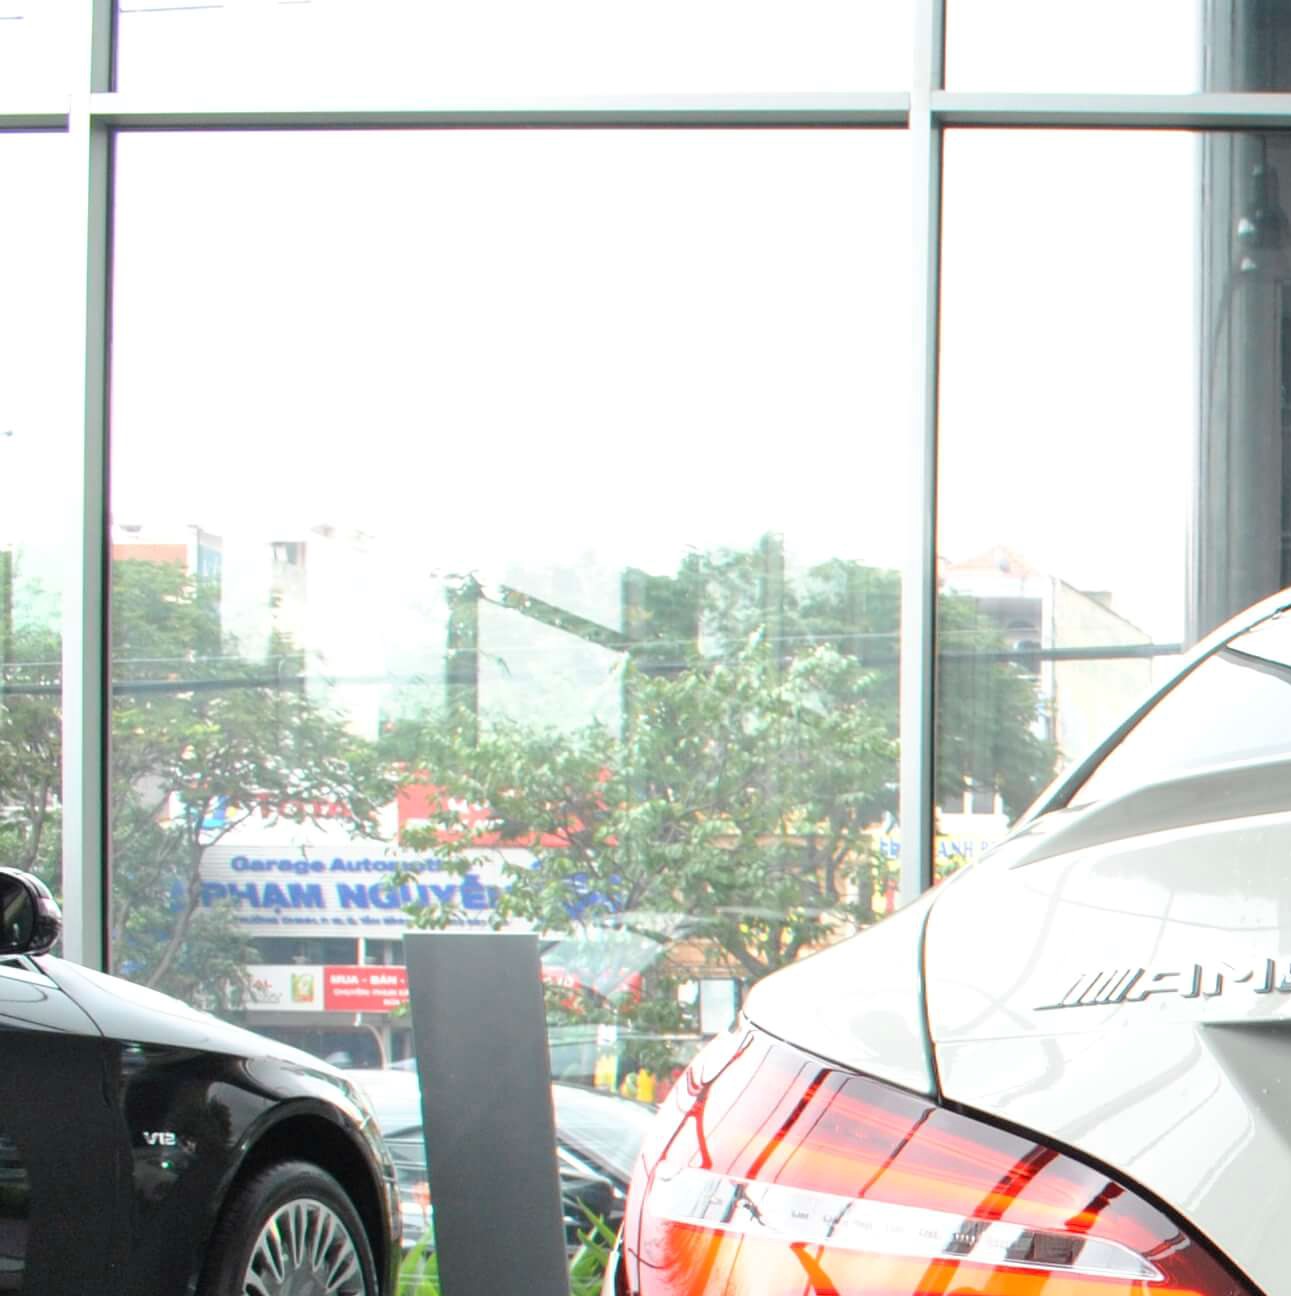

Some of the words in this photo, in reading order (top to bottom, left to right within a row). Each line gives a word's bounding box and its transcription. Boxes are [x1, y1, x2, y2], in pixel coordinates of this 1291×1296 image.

[255, 793, 352, 820] TOTA
[230, 856, 326, 874] Garage
[143, 1131, 176, 1146] V12
